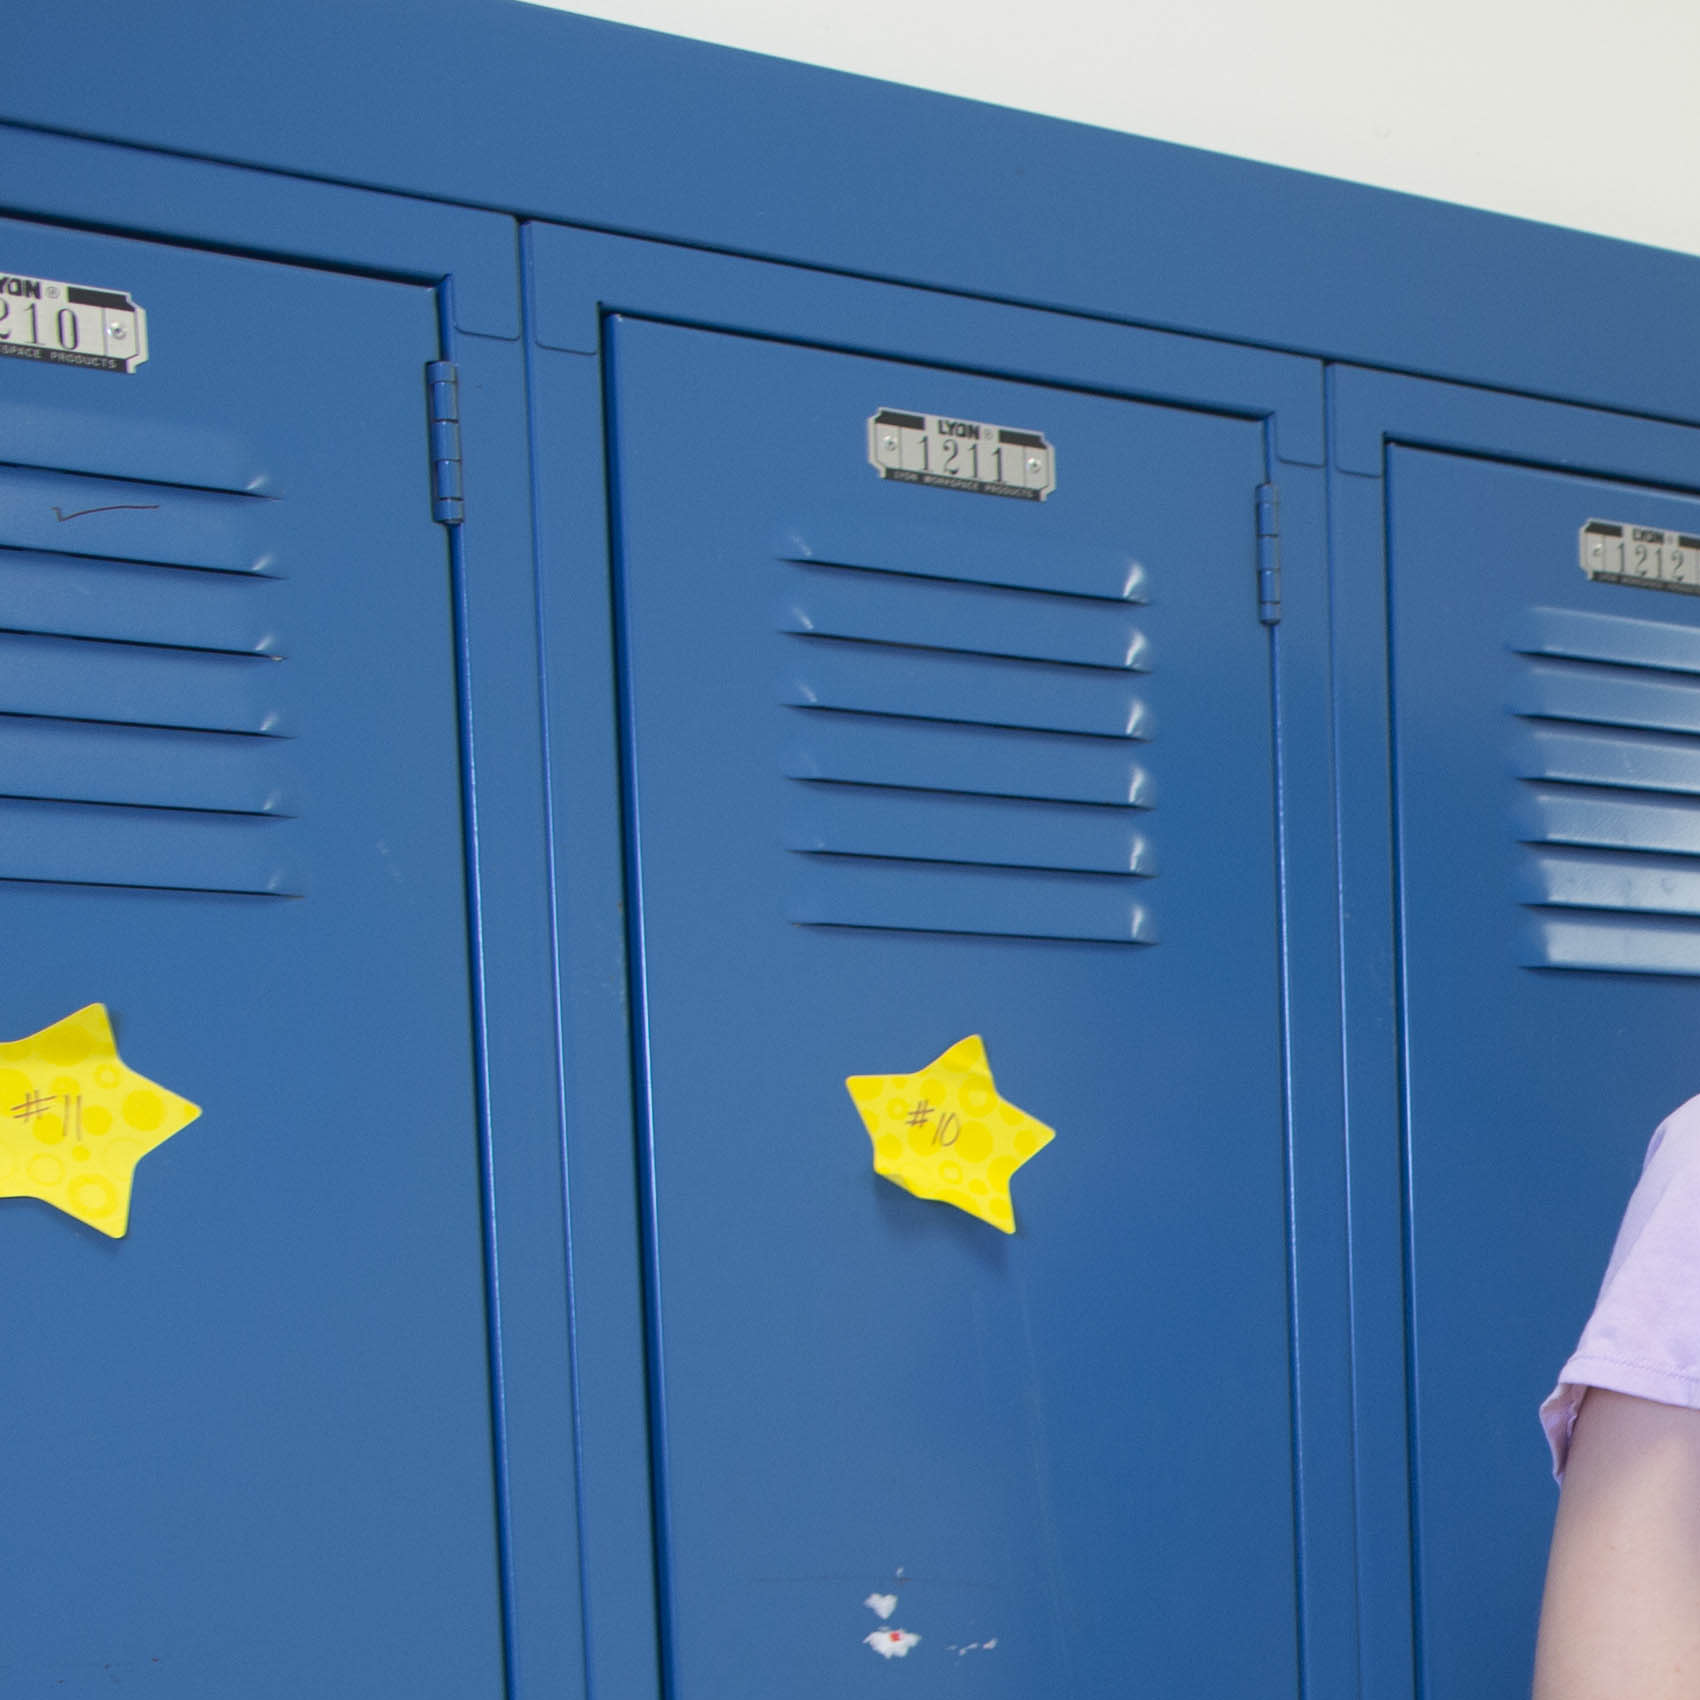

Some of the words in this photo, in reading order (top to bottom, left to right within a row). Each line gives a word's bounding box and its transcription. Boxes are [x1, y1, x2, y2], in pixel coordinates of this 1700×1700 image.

[938, 419, 980, 441] LYON
[918, 435, 1004, 483] 1211
[1617, 542, 1685, 582] 1212
[905, 1100, 961, 1147] #10
